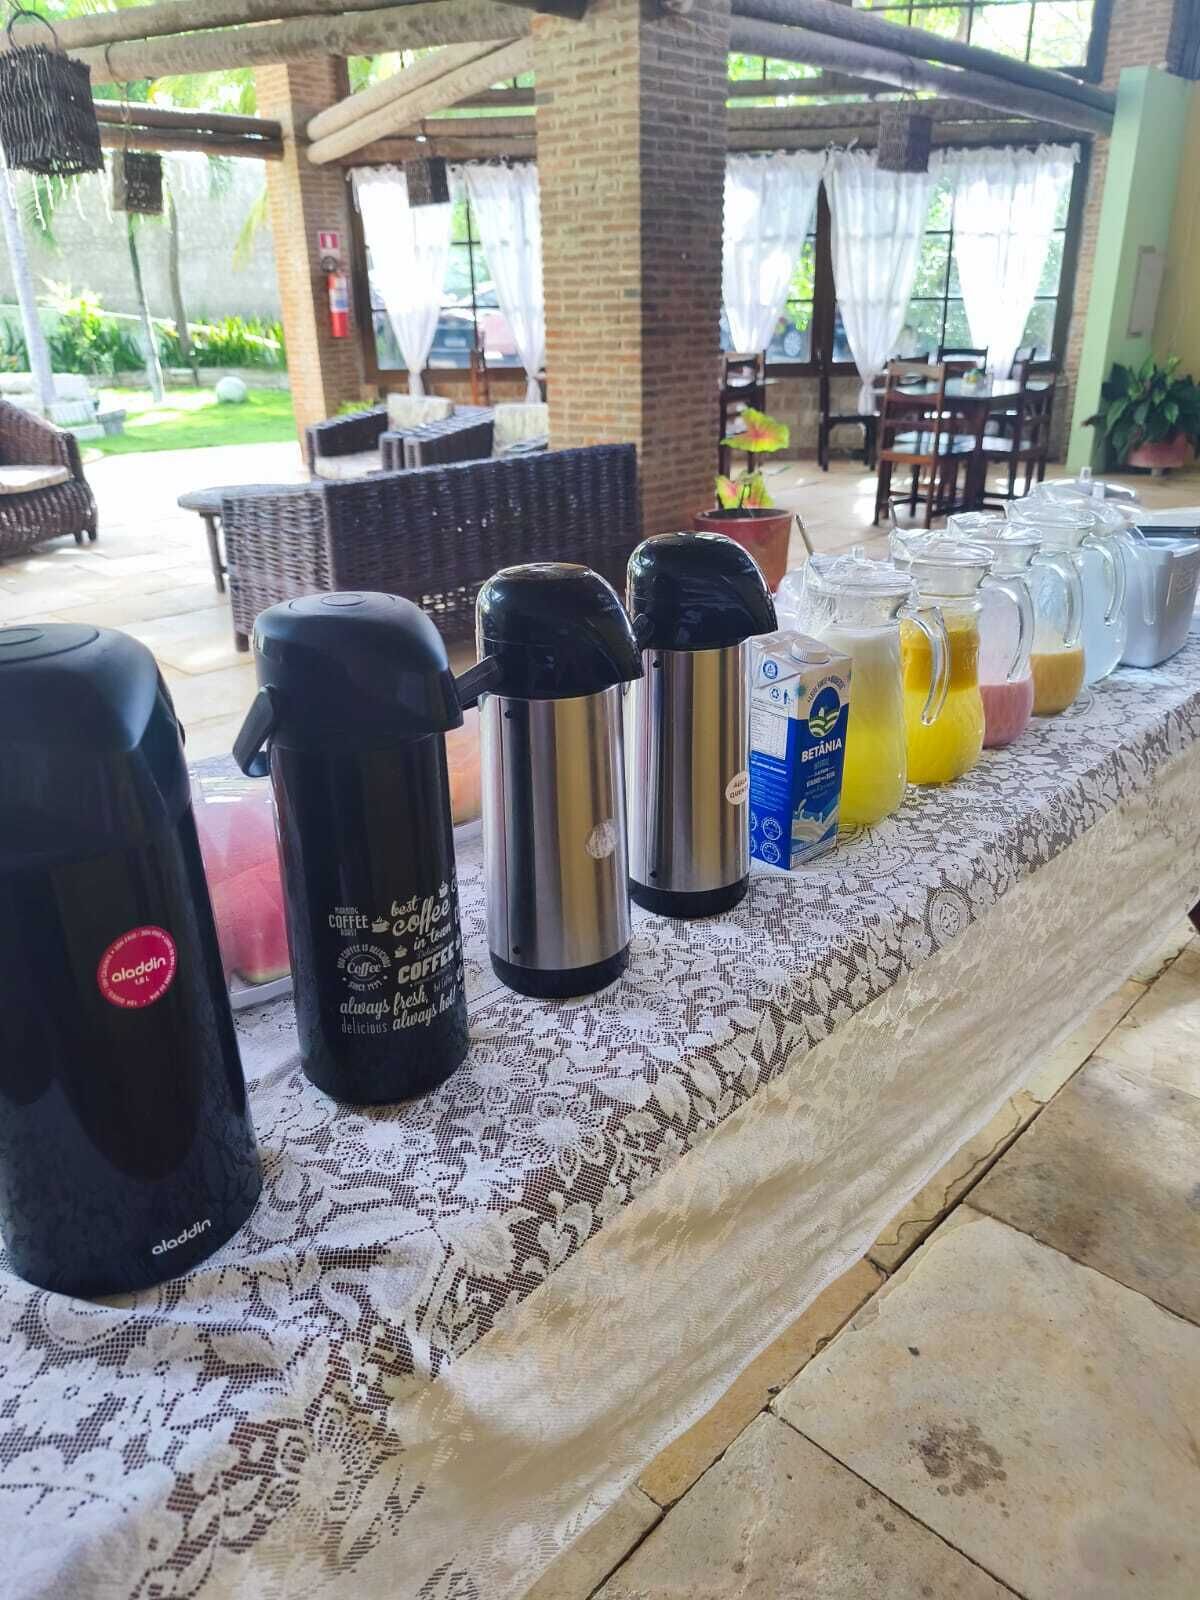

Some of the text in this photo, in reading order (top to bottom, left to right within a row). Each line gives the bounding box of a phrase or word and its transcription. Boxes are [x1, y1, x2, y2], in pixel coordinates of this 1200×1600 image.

[801, 738, 842, 763] BETÂNIA
[391, 895, 418, 917] best
[392, 896, 450, 936] coffee
[328, 914, 369, 928] COFFEE
[414, 936, 426, 950] in
[111, 956, 166, 982] aladdin
[347, 961, 381, 977] Coffee
[398, 941, 454, 985] COFFEE
[340, 996, 389, 1020] always
[393, 1003, 437, 1031] always
[341, 1015, 387, 1034] delicious
[152, 1219, 211, 1255] aladdin
